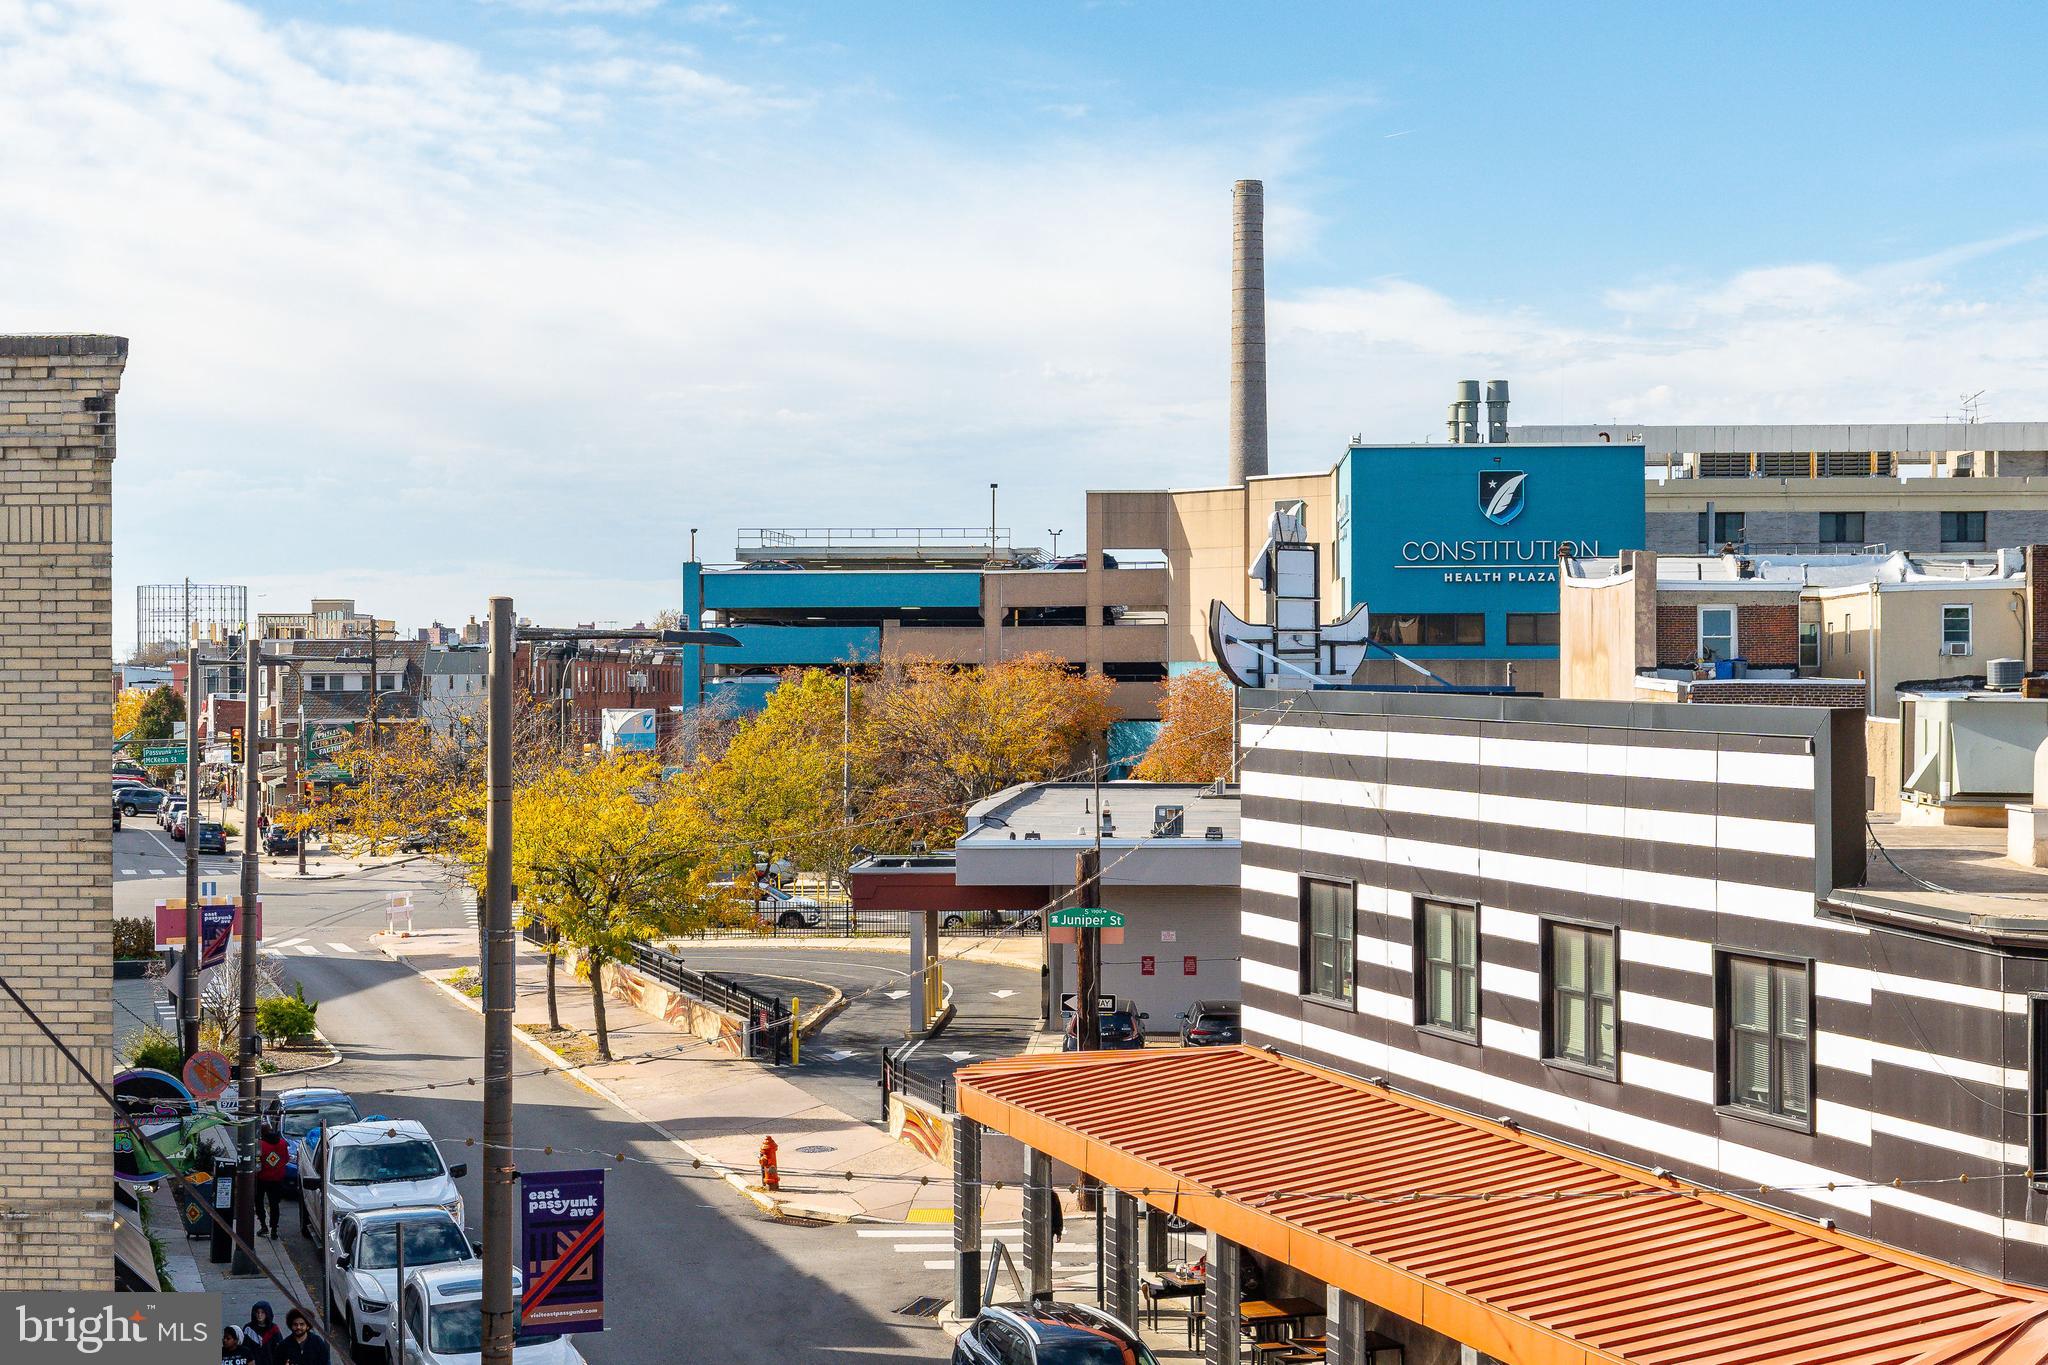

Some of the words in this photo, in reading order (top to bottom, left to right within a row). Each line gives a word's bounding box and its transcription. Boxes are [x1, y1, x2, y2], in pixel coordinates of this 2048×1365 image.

[1402, 540, 1598, 561] CONSTITUTION
[1444, 573, 1501, 582] HEALTH
[1508, 572, 1556, 582] PLAZA
[319, 744, 343, 754] FACTOR
[1061, 915, 1105, 927] Juniper
[1110, 915, 1122, 926] St
[529, 1188, 560, 1200] east
[529, 1195, 598, 1215] passyunk
[570, 1207, 594, 1217] ave
[530, 1308, 598, 1318] visiteastpassyunk.com
